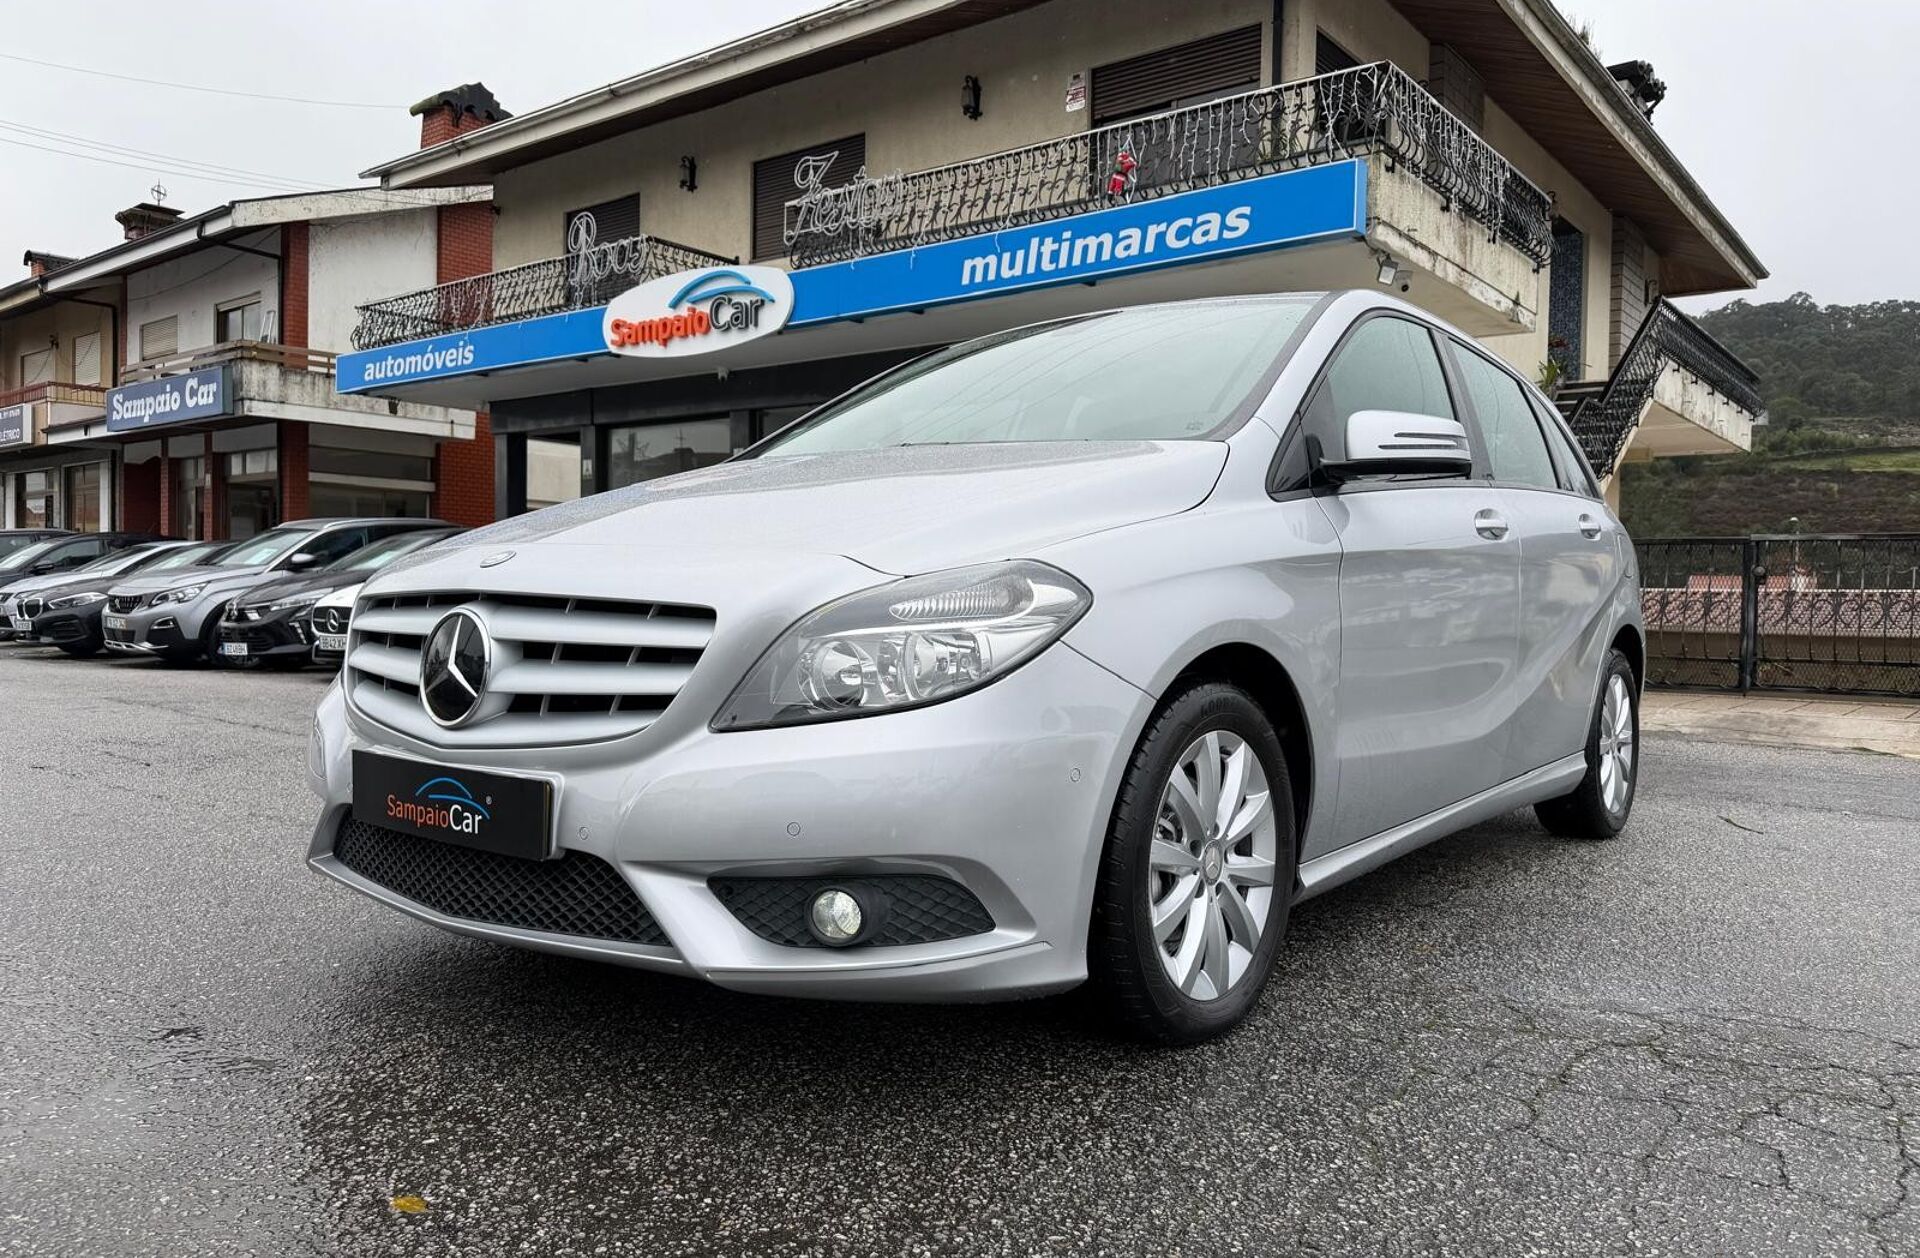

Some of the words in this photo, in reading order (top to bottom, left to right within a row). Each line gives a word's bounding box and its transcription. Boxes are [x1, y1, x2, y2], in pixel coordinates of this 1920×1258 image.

[961, 206, 1251, 285] multimarcas
[364, 340, 474, 381] automóveis
[112, 384, 181, 423] Sampaio
[185, 377, 217, 408] Car
[387, 794, 482, 834] SampaioCar
